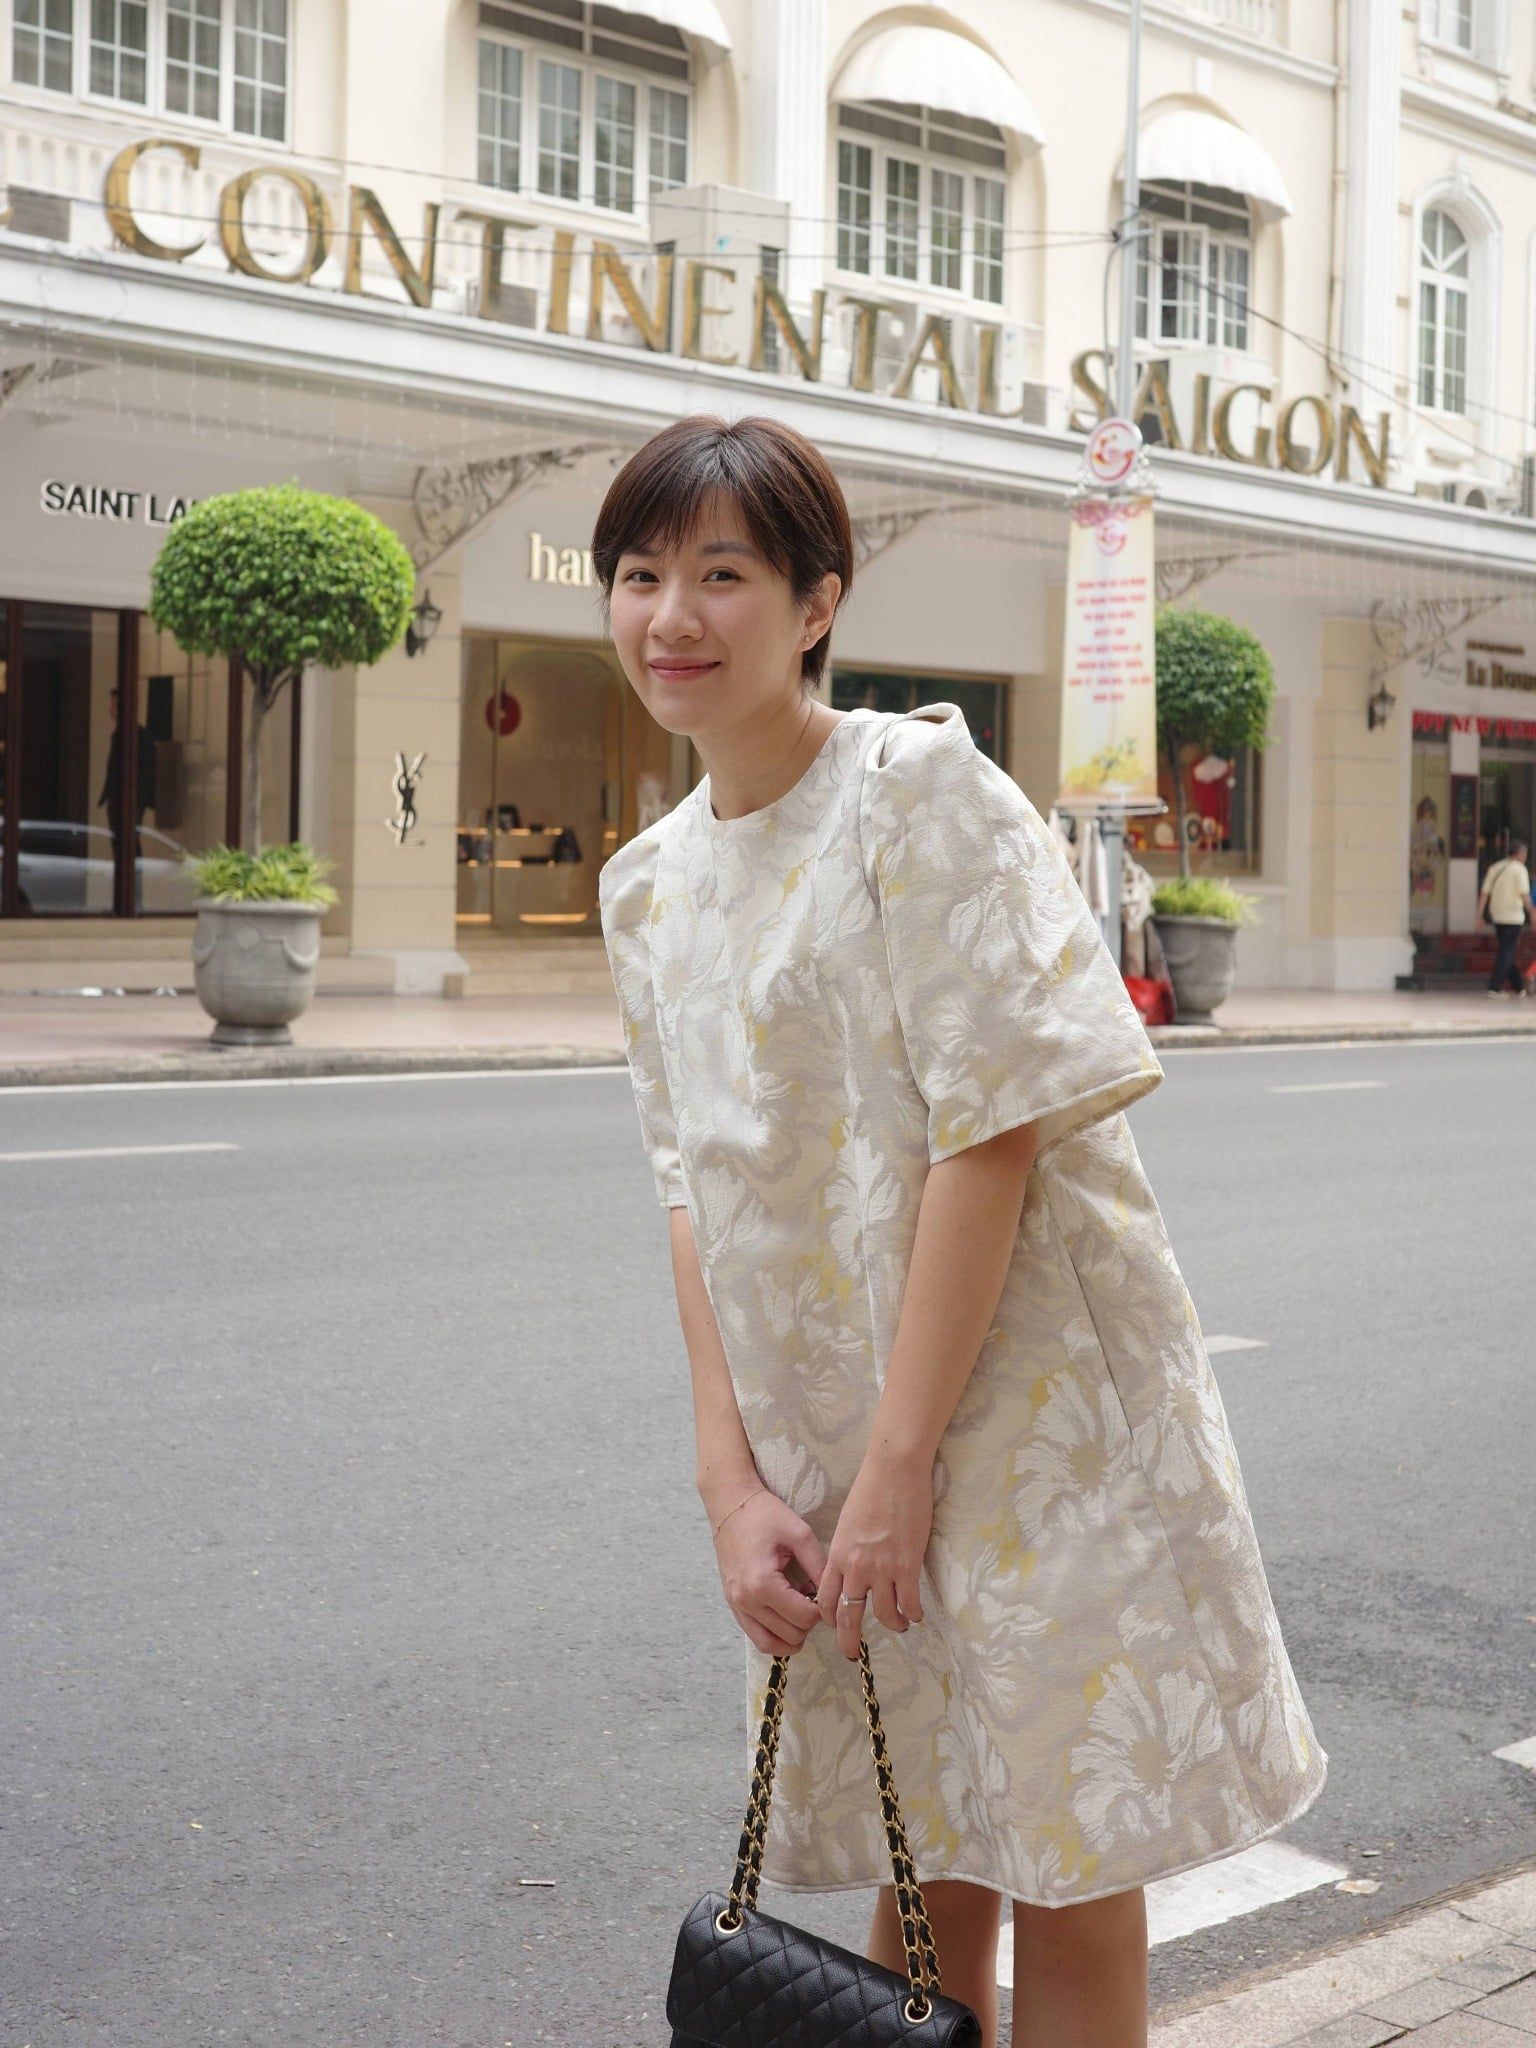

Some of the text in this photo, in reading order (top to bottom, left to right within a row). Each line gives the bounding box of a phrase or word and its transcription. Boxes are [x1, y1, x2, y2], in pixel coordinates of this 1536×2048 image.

[104, 138, 1391, 487] CONTINENTAL SAIGON
[42, 480, 197, 526] SAINT LA
